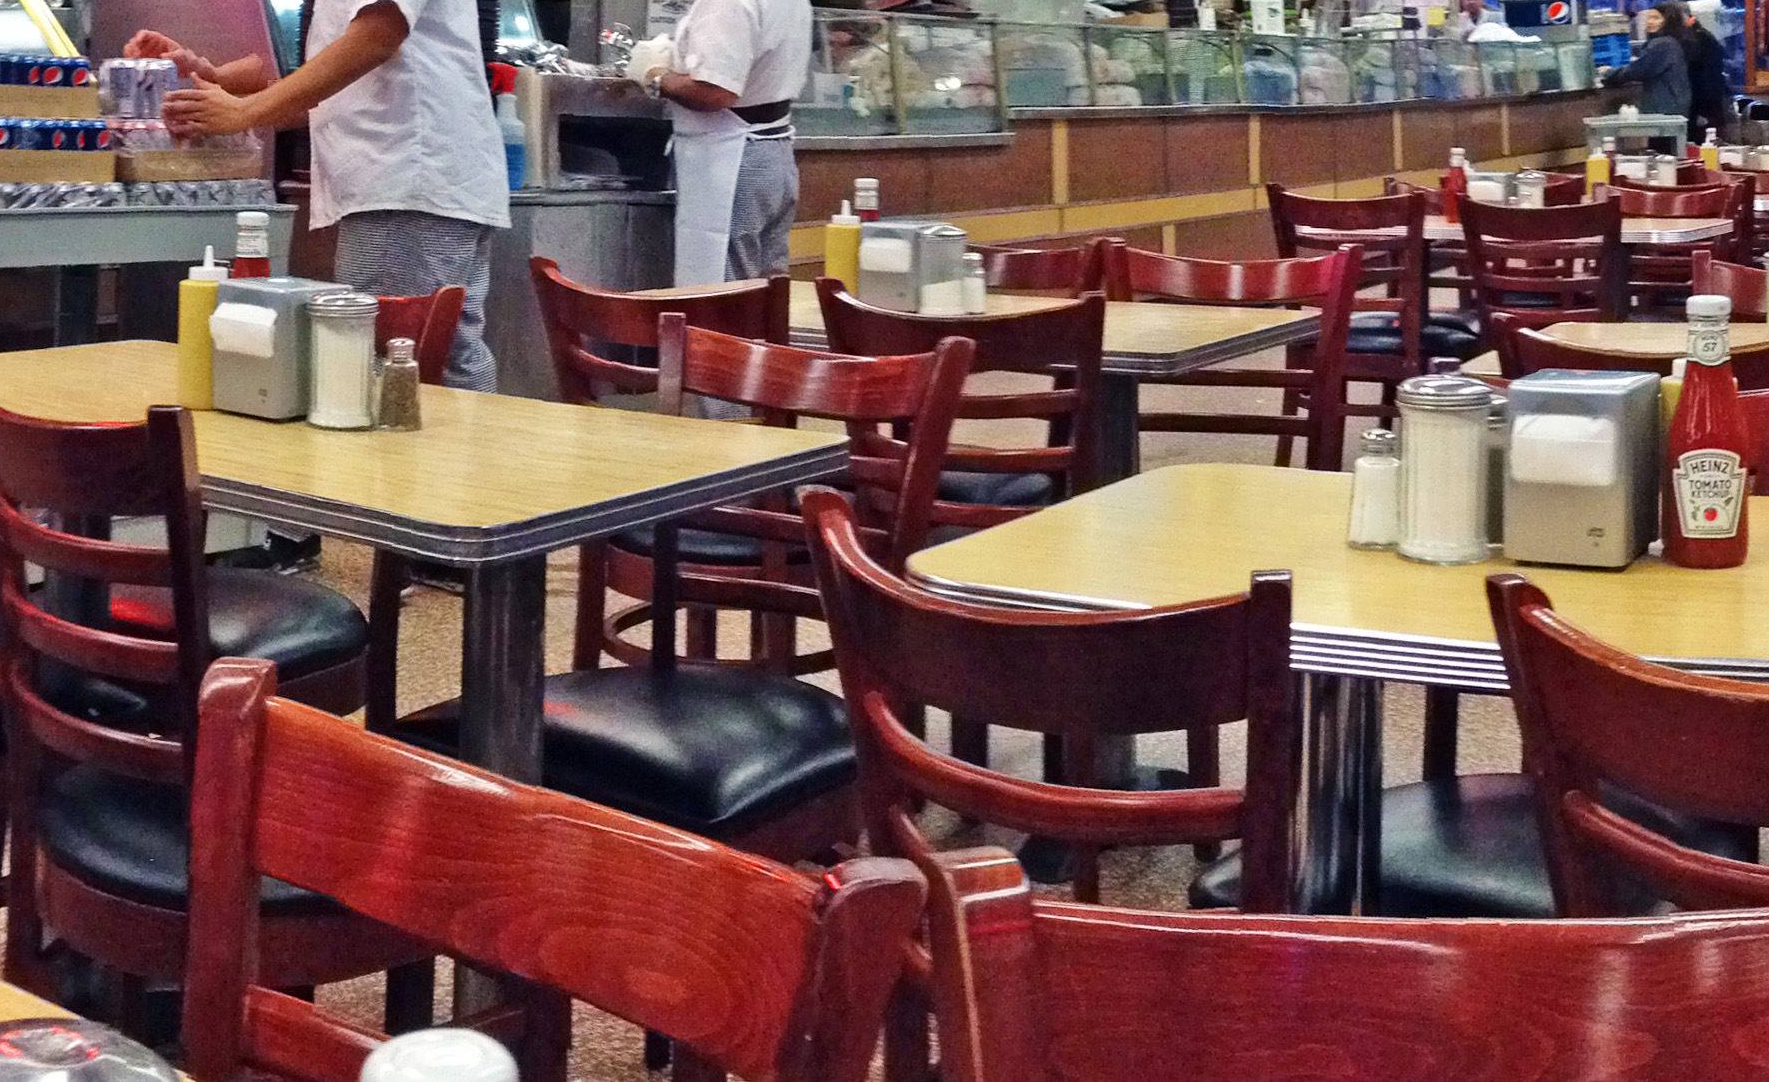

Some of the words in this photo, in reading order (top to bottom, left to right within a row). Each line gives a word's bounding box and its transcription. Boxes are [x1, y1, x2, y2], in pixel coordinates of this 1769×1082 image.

[1702, 342, 1718, 352] 57
[1690, 460, 1729, 474] HEINZ
[1688, 479, 1732, 490] TOMATO
[1691, 490, 1731, 498] KETCHUP
